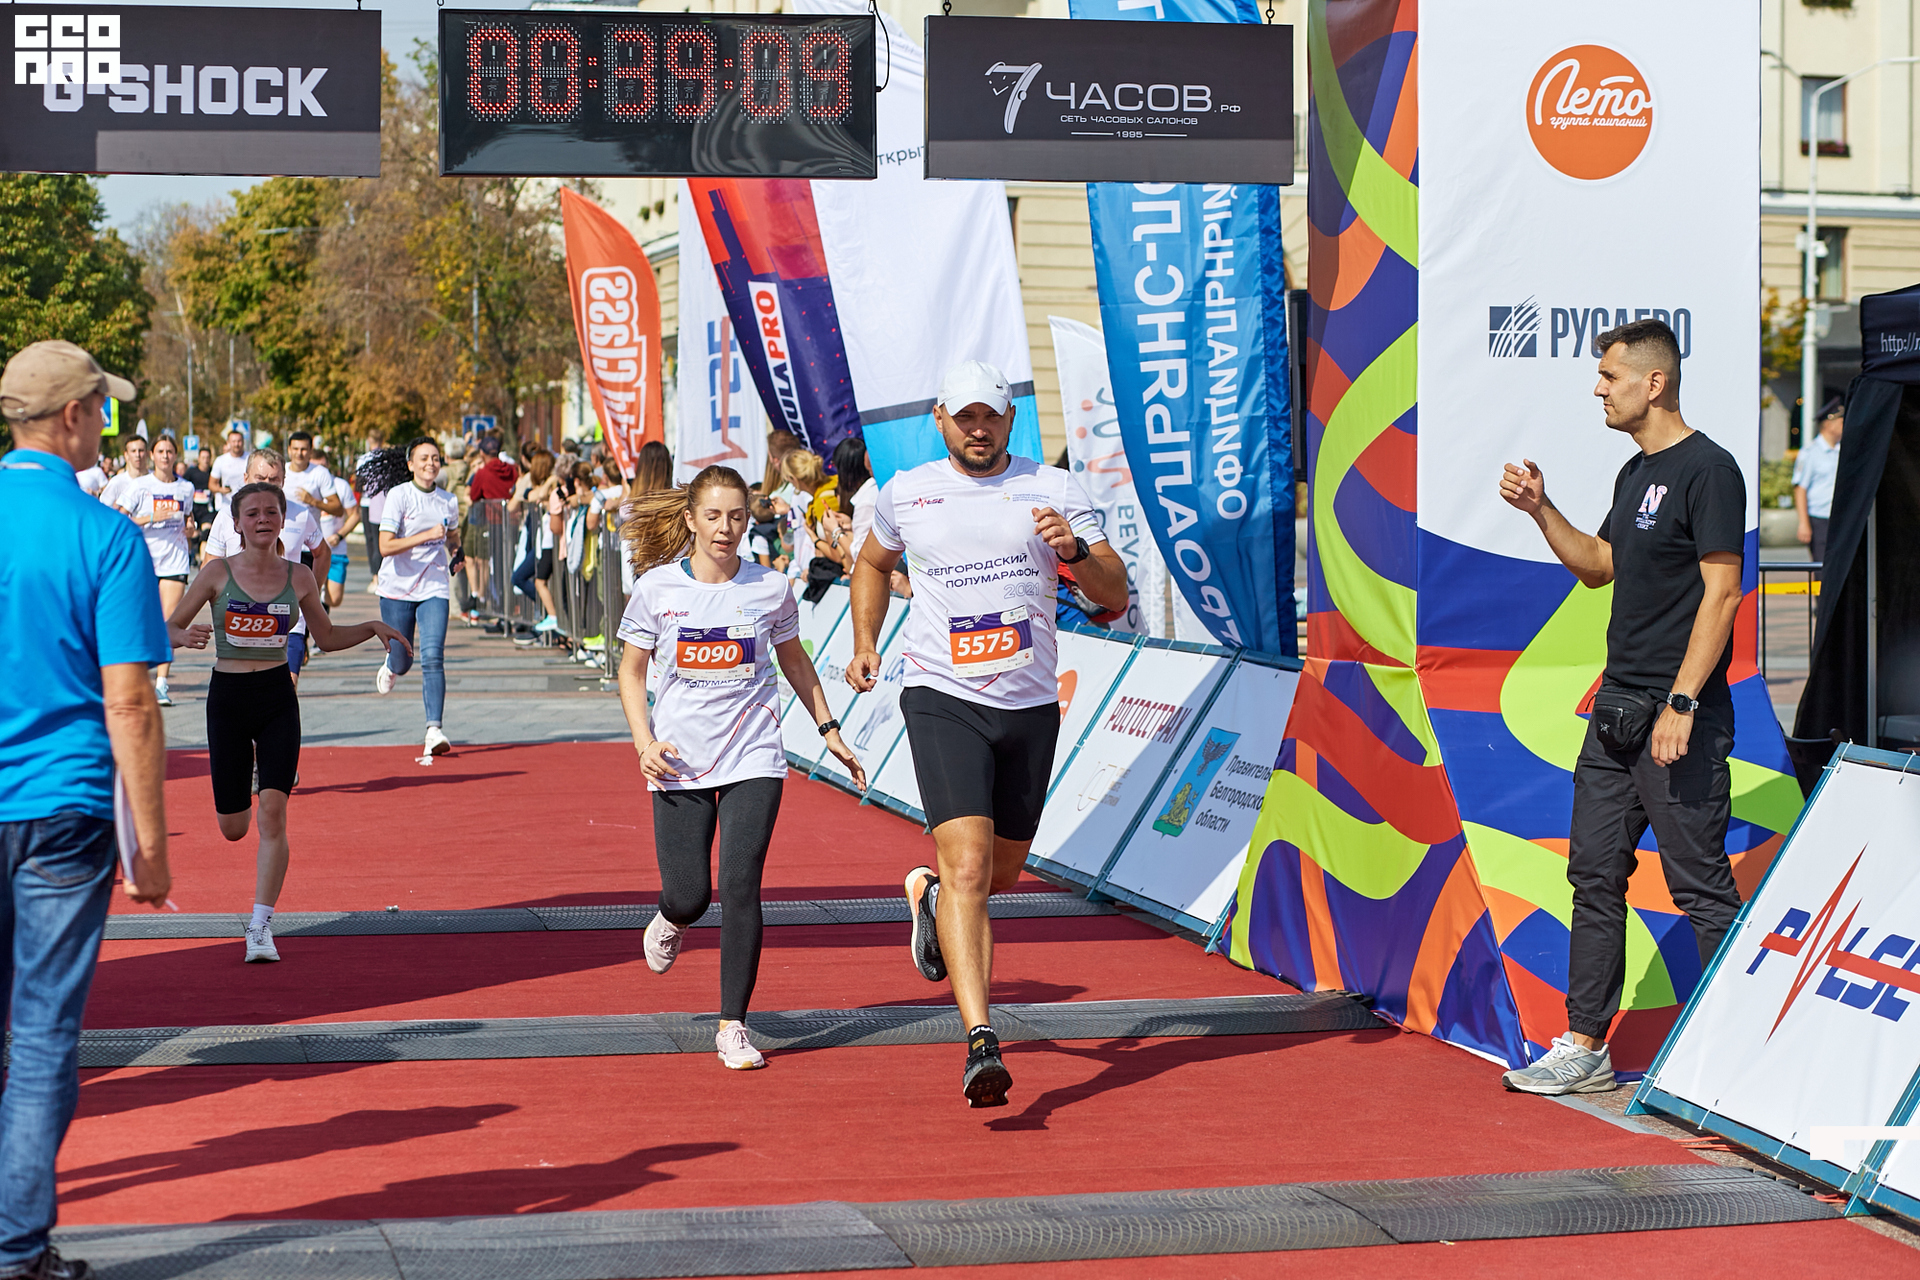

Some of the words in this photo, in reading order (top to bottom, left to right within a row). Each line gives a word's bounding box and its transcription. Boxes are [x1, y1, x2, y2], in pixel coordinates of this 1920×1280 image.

[467, 27, 850, 118] 00:39:09
[1534, 58, 1654, 126] Лето
[1060, 114, 1087, 123] СЕТЬ
[1090, 115, 1144, 124] ЧАСОВЫХ
[1146, 116, 1198, 125] САЛОНОВ
[1550, 116, 1591, 130] группа
[1591, 116, 1648, 127] компаний
[1115, 130, 1143, 139] 1995
[927, 552, 1028, 577] БЕЛГОРОДСКИЙ
[945, 567, 1040, 589] ПОЛУМАРАФОН
[1003, 581, 1040, 600] 2021
[228, 615, 275, 633] 5282
[682, 644, 738, 663] 5090
[957, 629, 1014, 657] 5575
[1103, 695, 1193, 745] РОСГОССТРАХ
[1194, 809, 1232, 834] области
